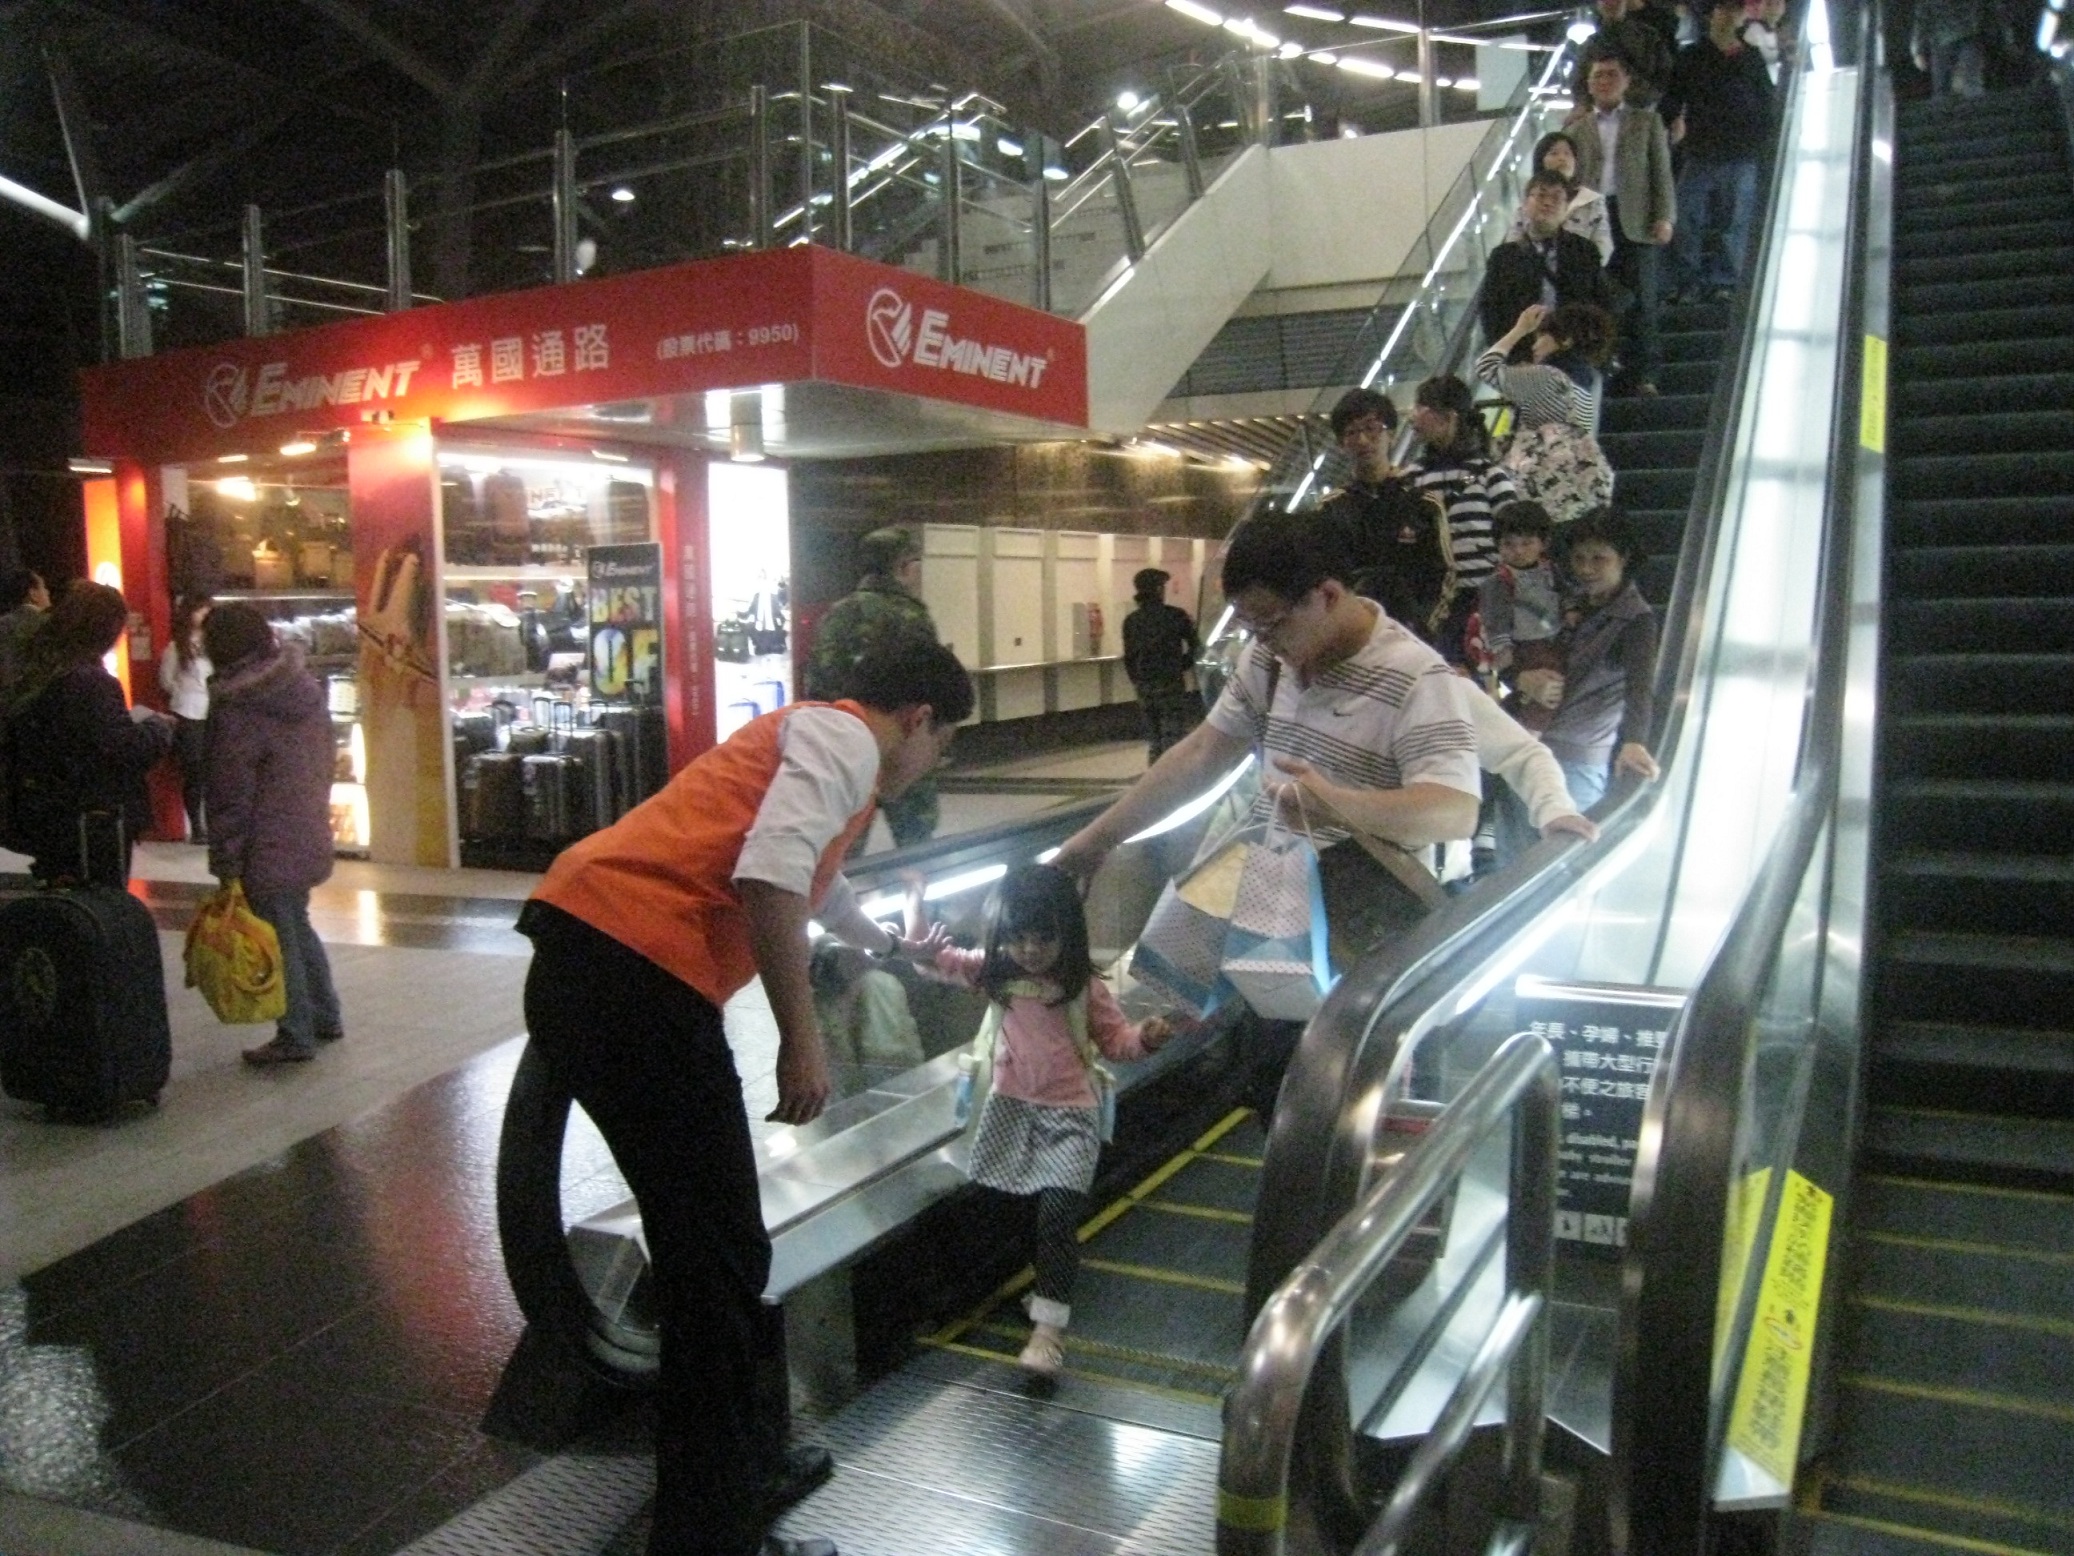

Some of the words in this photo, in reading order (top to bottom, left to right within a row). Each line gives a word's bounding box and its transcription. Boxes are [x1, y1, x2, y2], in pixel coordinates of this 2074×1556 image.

[451, 323, 610, 391] 萬國通路
[912, 308, 1048, 389] EMINENT
[250, 358, 421, 419] EMINENT
[591, 585, 658, 624] BEST
[593, 627, 659, 695] OF
[1558, 1076, 1651, 1100] 不便之旅客
